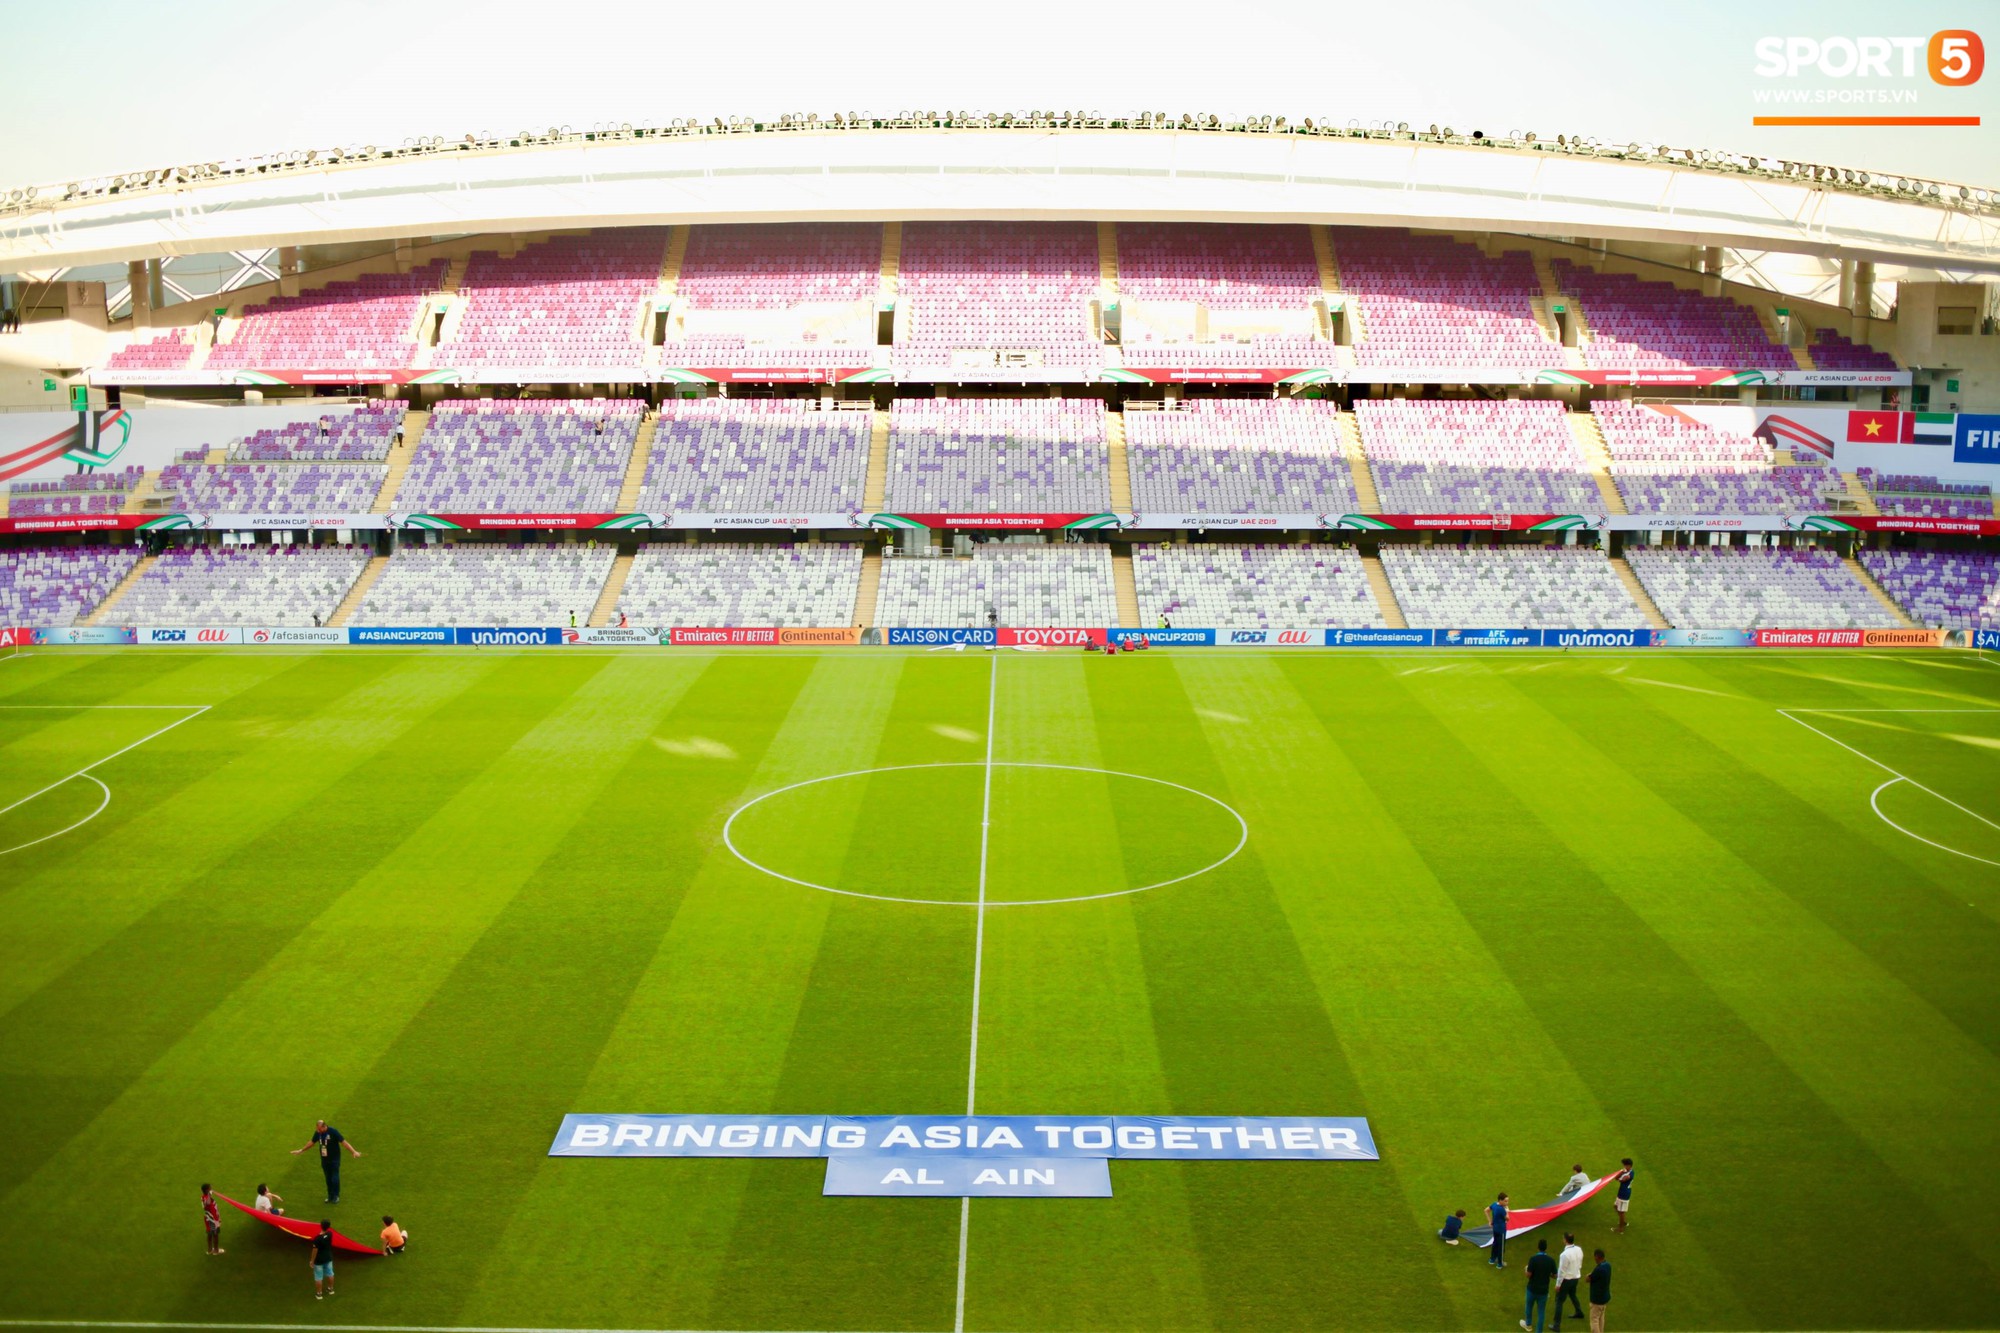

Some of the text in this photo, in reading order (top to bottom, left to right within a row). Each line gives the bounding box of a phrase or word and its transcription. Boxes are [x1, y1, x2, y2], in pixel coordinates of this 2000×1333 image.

[15, 521, 54, 529] BRINGING
[1936, 522, 1980, 531] TOGETHER
[152, 628, 230, 642] KDDI au
[272, 631, 339, 642] /afcasiancup
[359, 632, 445, 640] #ASIANCUP2019
[676, 630, 774, 642] Emirates FLY BETTER
[781, 630, 845, 642] Continental
[892, 630, 994, 643] SAISON CARD
[1014, 630, 1088, 644] TOYOTA
[1231, 630, 1312, 644] KDDI au
[1344, 632, 1423, 643] @theafcasiancup
[1762, 632, 1860, 644] Emirates FLY BETTER
[1866, 632, 1928, 644] Continental
[570, 1124, 1360, 1150] BRINGING ASIA TOGETHER
[880, 1168, 1055, 1185] AL AIN
